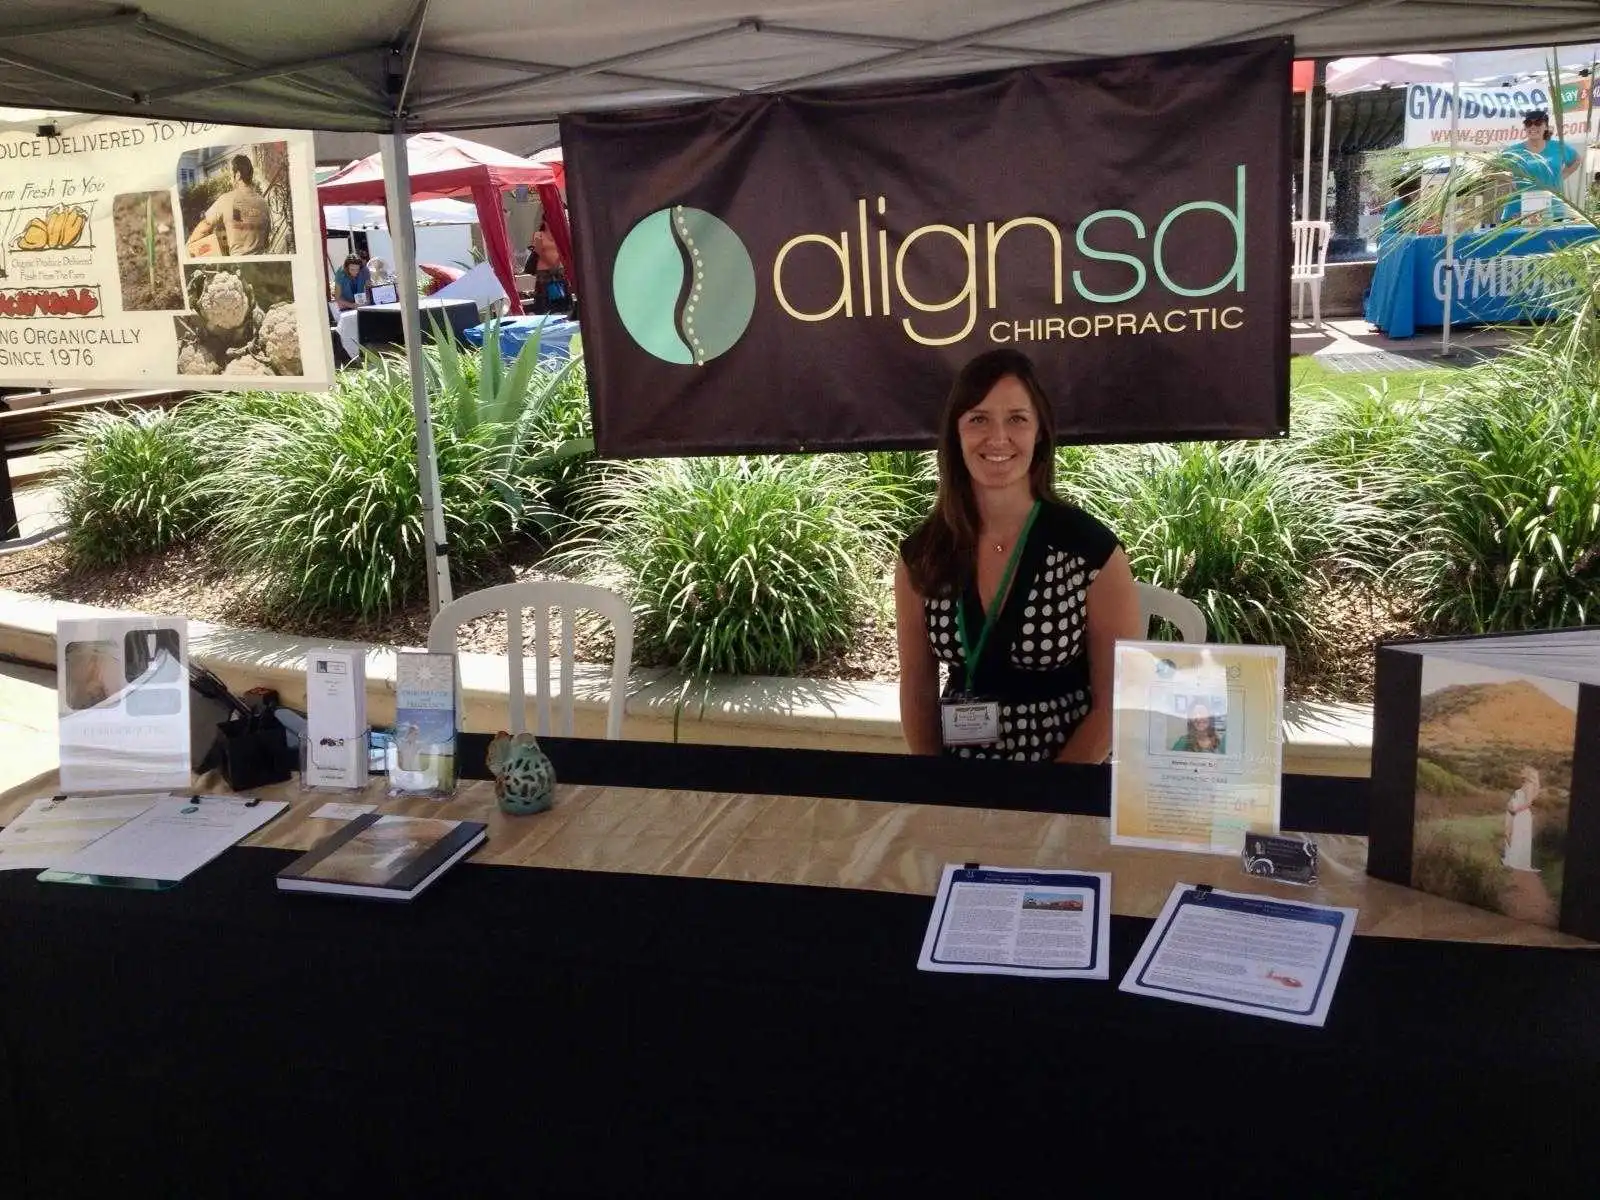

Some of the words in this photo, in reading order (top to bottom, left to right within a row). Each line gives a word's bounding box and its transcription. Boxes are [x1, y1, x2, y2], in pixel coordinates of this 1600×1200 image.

[47, 128, 145, 156] DELIVERED
[147, 122, 175, 143] TO
[20, 179, 55, 200] Fresh
[62, 179, 76, 197] To
[82, 176, 105, 196] You
[23, 327, 141, 345] ORGANICALLY
[989, 306, 1245, 343] CHIROPRACTIC
[0, 349, 44, 366] SINCE
[50, 348, 94, 366] 1976
